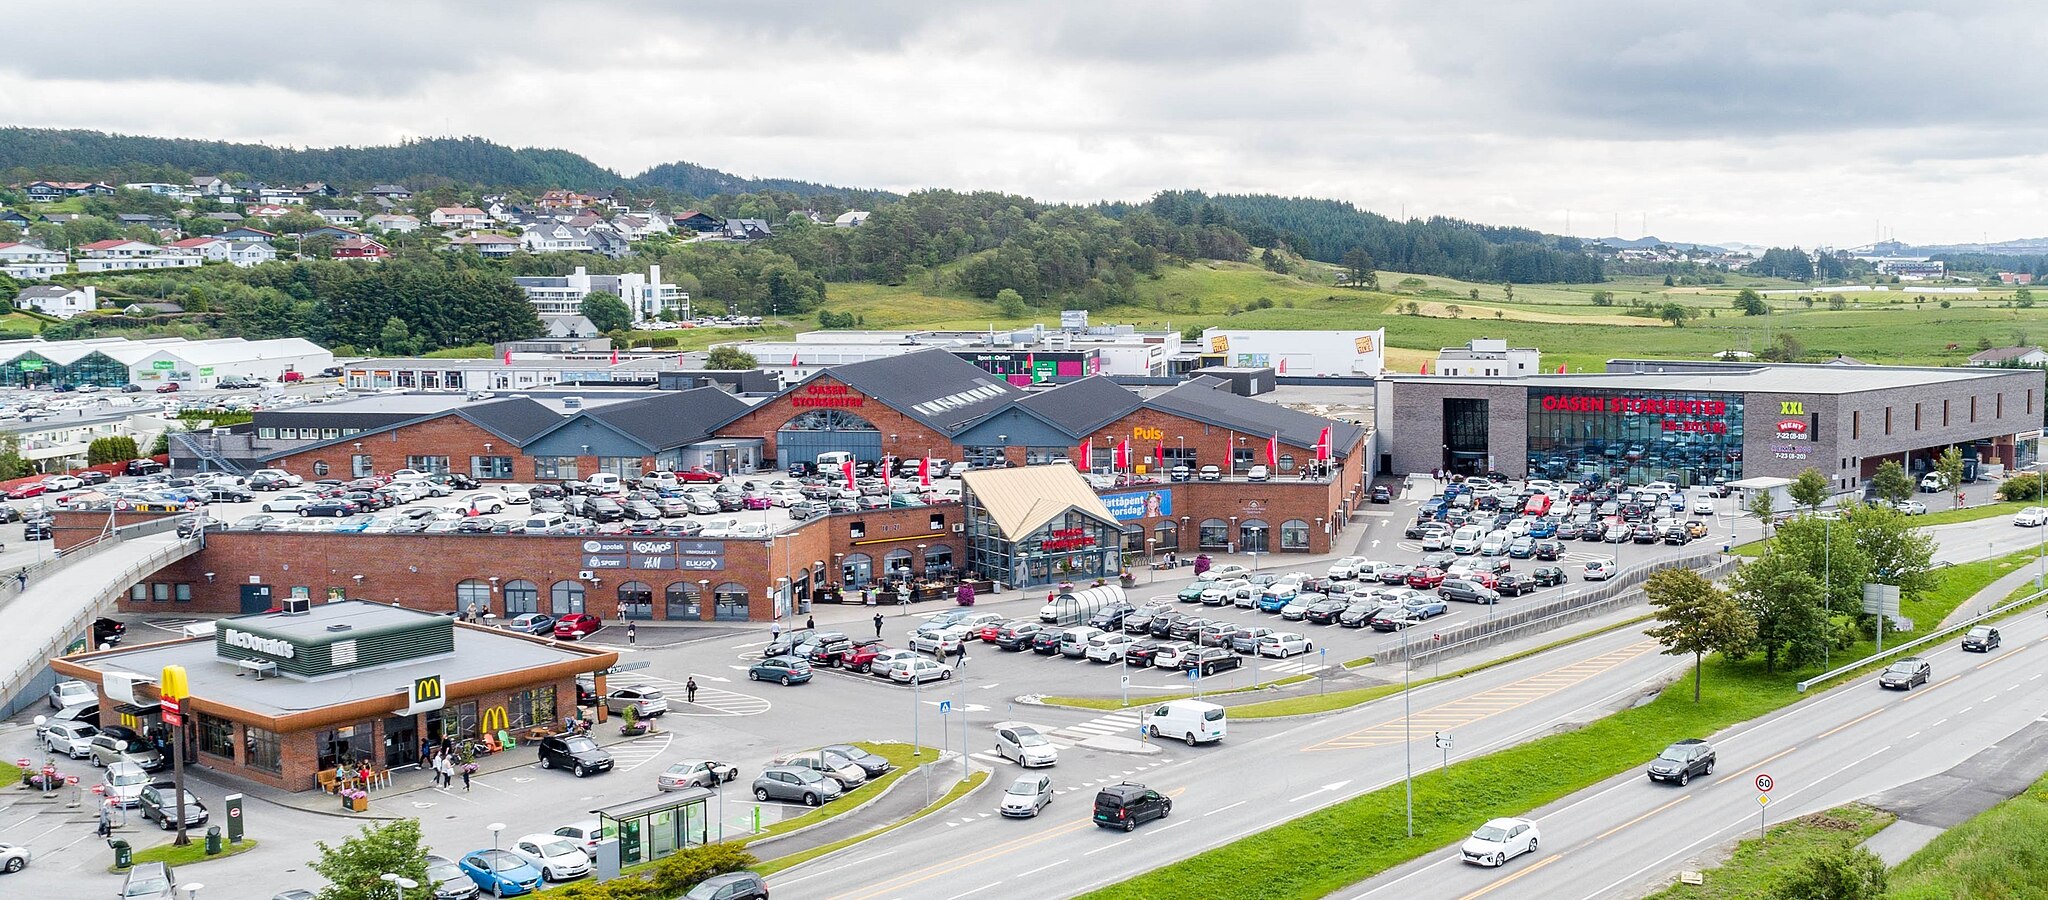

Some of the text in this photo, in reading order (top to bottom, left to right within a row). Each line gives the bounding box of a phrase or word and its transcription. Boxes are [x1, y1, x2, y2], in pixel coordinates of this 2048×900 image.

[808, 385, 847, 395] OASEN
[792, 397, 863, 407] STORSENTER
[1542, 395, 1726, 415] OASEN STORSENTER
[1780, 402, 1804, 415] XXL
[1780, 422, 1803, 430] MENY
[1111, 505, 1144, 516] torsdag!
[602, 543, 624, 551] apotek
[633, 541, 672, 553] KOZMOS
[644, 557, 661, 568] H&M
[1759, 778, 1770, 788] 60
